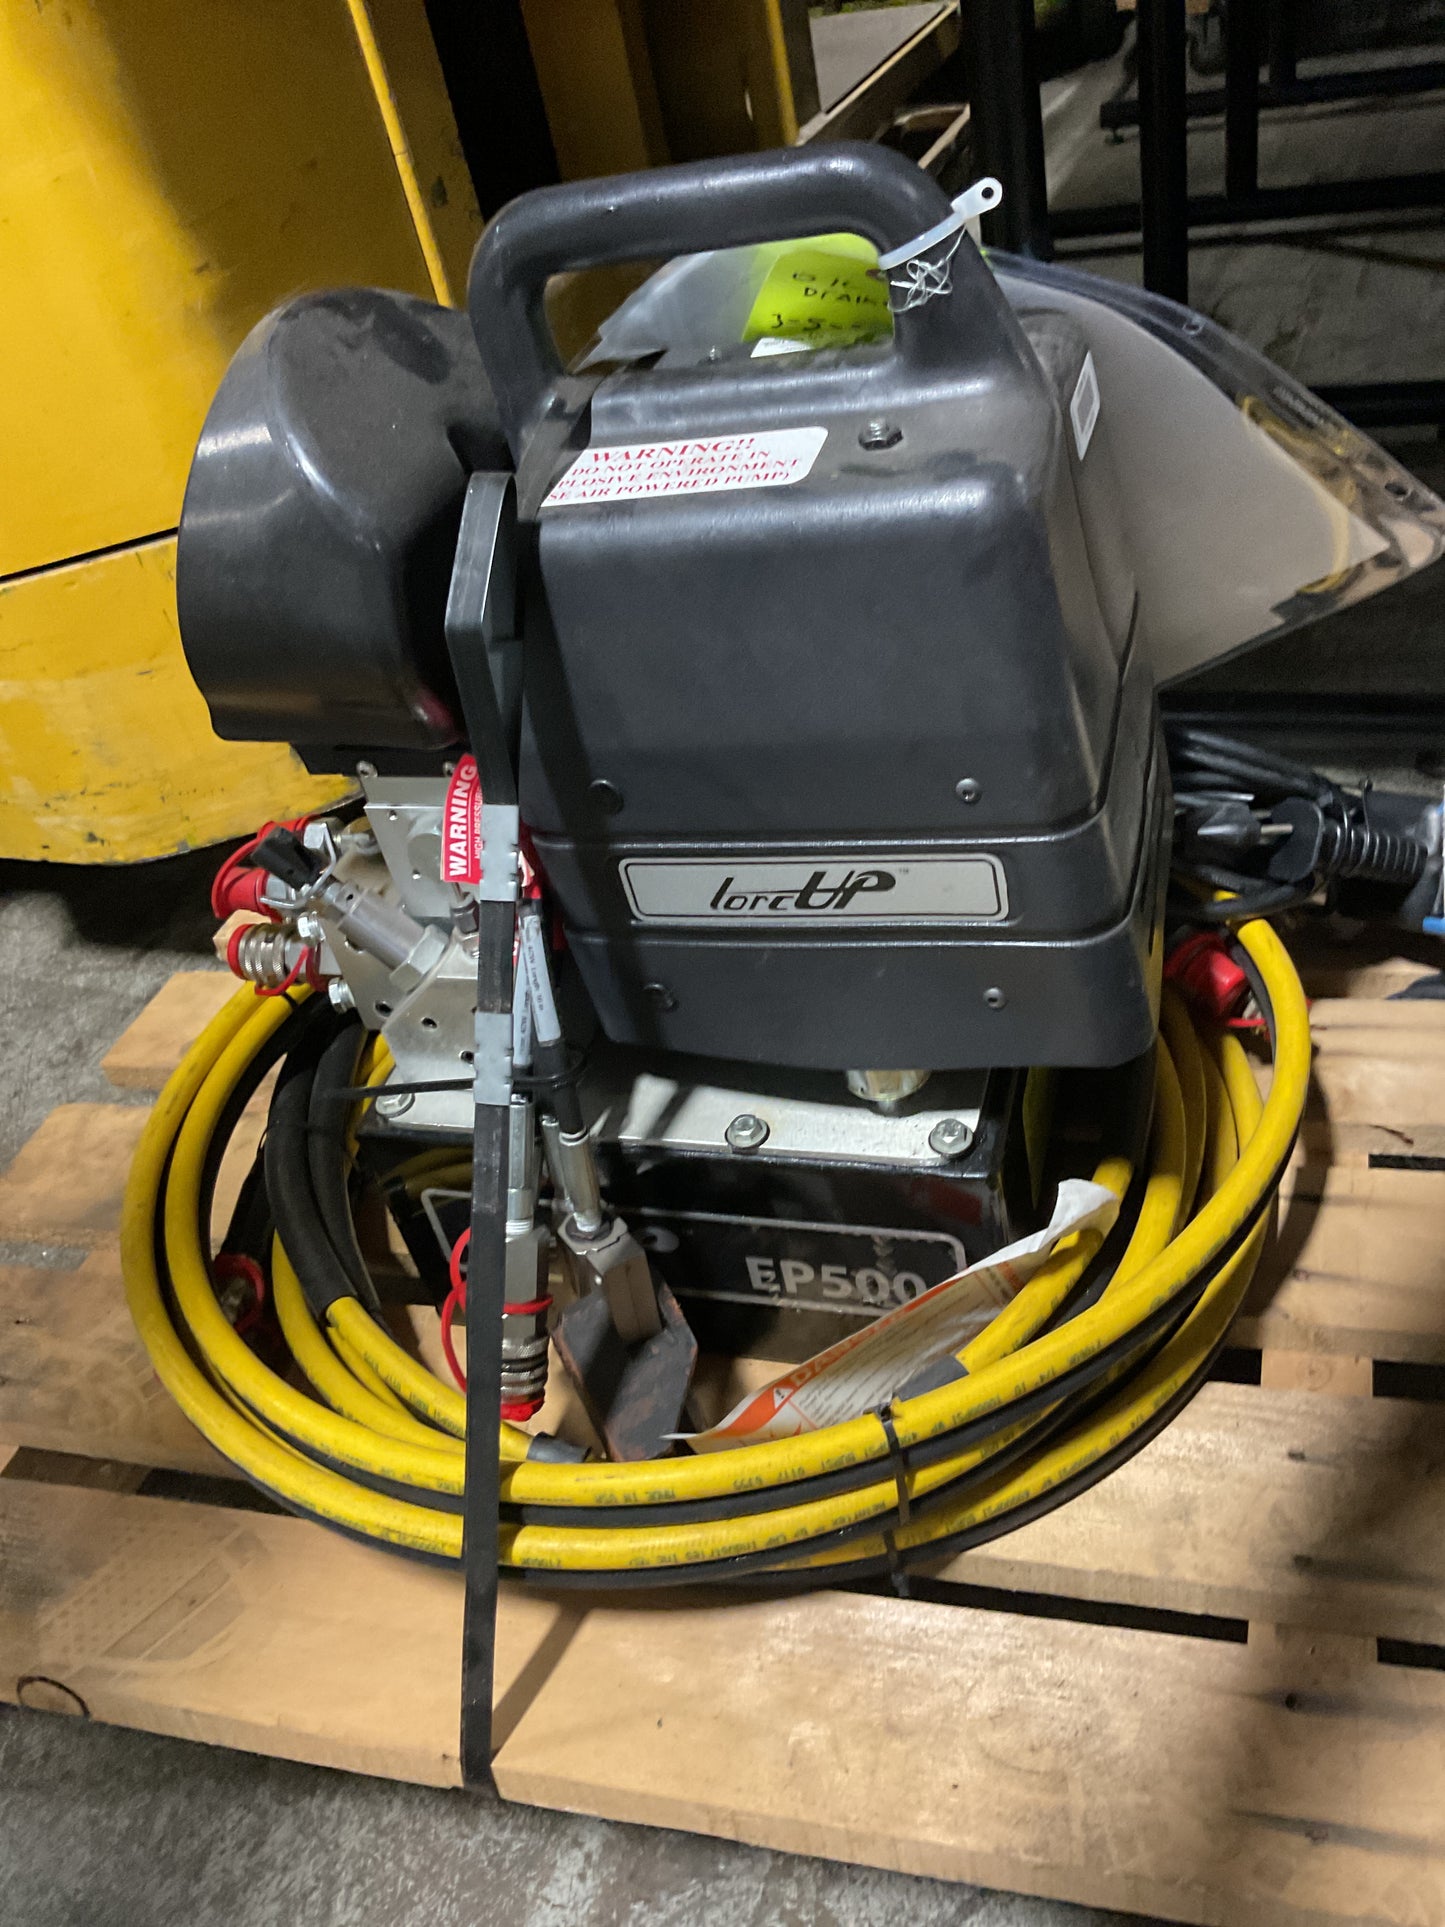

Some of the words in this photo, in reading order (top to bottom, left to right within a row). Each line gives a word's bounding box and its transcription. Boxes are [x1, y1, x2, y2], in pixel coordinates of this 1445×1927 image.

[572, 466, 599, 476] DO
[604, 462, 646, 473] NOT
[650, 453, 741, 469] OPERATE
[749, 449, 771, 460] IN
[592, 437, 756, 463] WARNING!!
[646, 459, 800, 481] ENVIRONMENT
[574, 487, 611, 498] AIR
[615, 478, 720, 496] POWERED
[724, 470, 790, 485] PUMP)
[448, 764, 478, 877] WARNING
[745, 1256, 928, 1304] EP500
